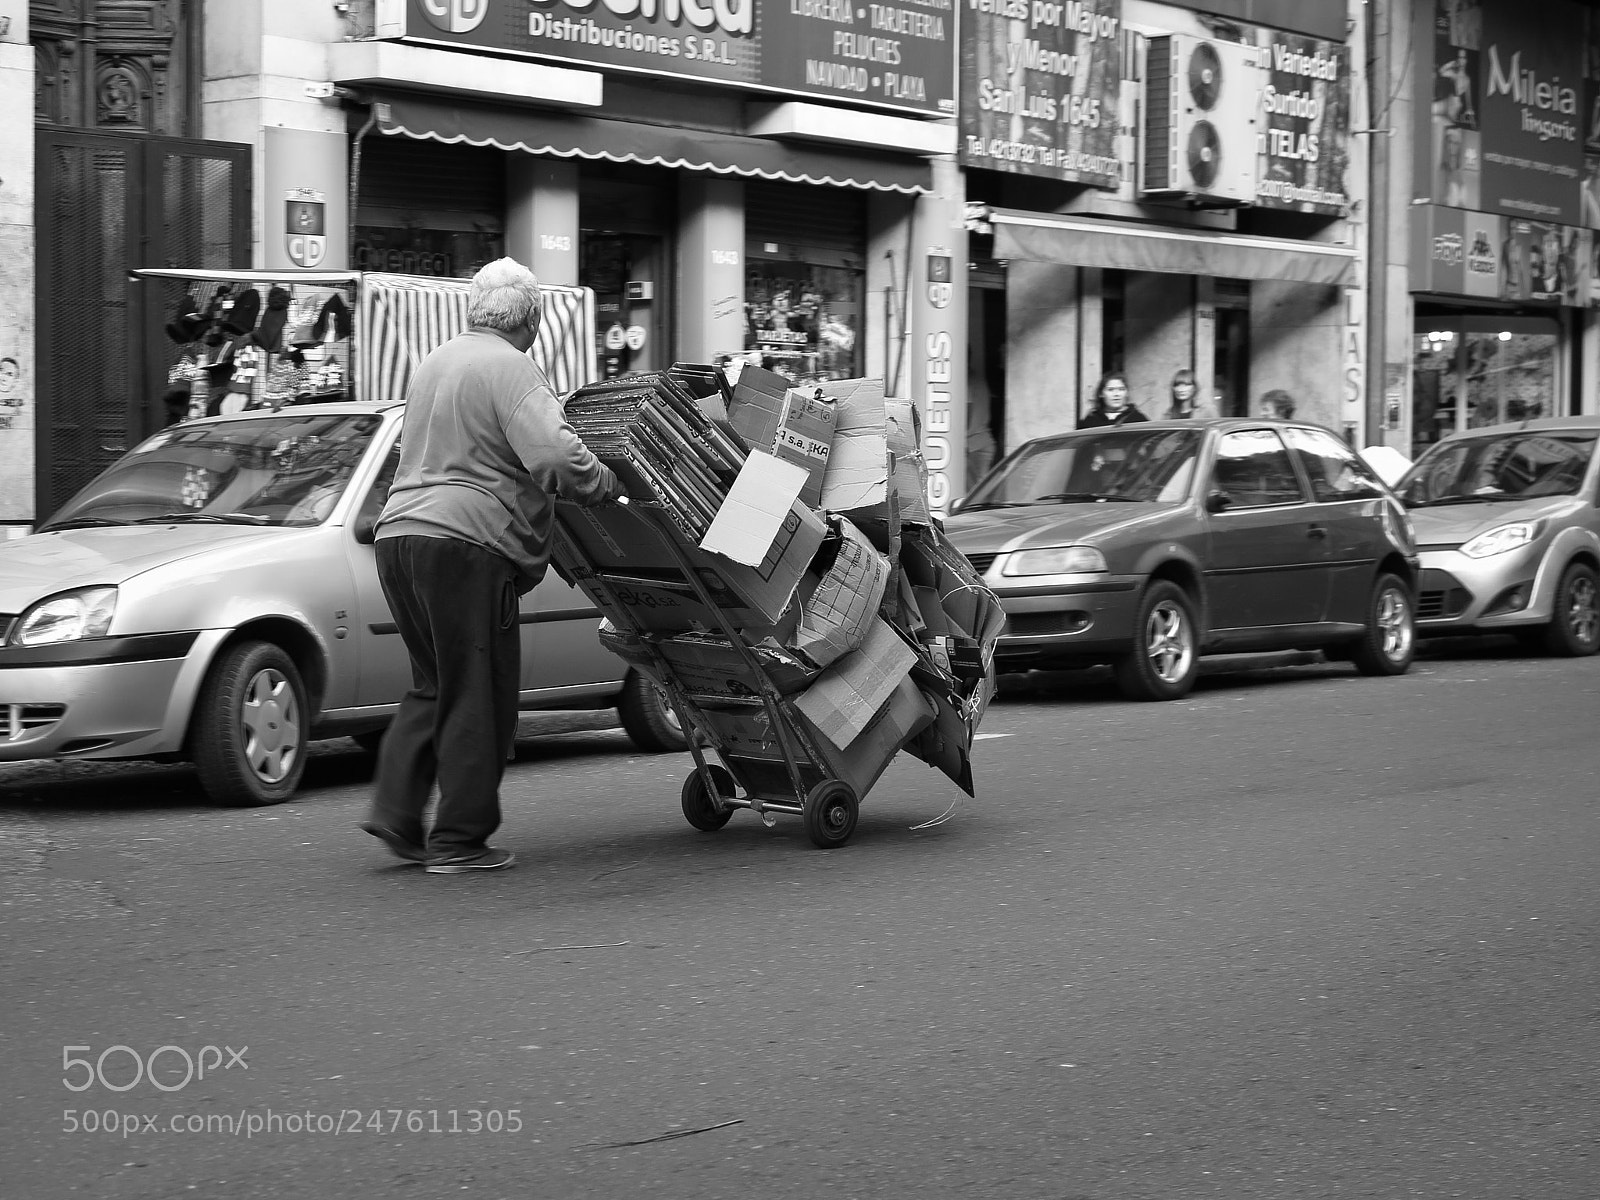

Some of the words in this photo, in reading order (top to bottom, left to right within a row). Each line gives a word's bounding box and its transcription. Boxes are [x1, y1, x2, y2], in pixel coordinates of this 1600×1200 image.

[528, 12, 680, 57] Distribuciones
[684, 35, 737, 65] S.R.L.
[1031, 1, 1063, 29] por
[1065, 0, 1118, 42] Mayor
[833, 30, 901, 65] PELUCHES
[1023, 38, 1079, 77] Menor
[1272, 43, 1338, 81] Variedad
[806, 59, 869, 92] NAVIDAD
[884, 72, 927, 101] PLAYA
[979, 78, 1014, 113] San
[1016, 85, 1058, 121] Luis
[1060, 93, 1101, 129] 1645
[1263, 84, 1318, 120] Surtido
[1268, 128, 1320, 162] TELAS
